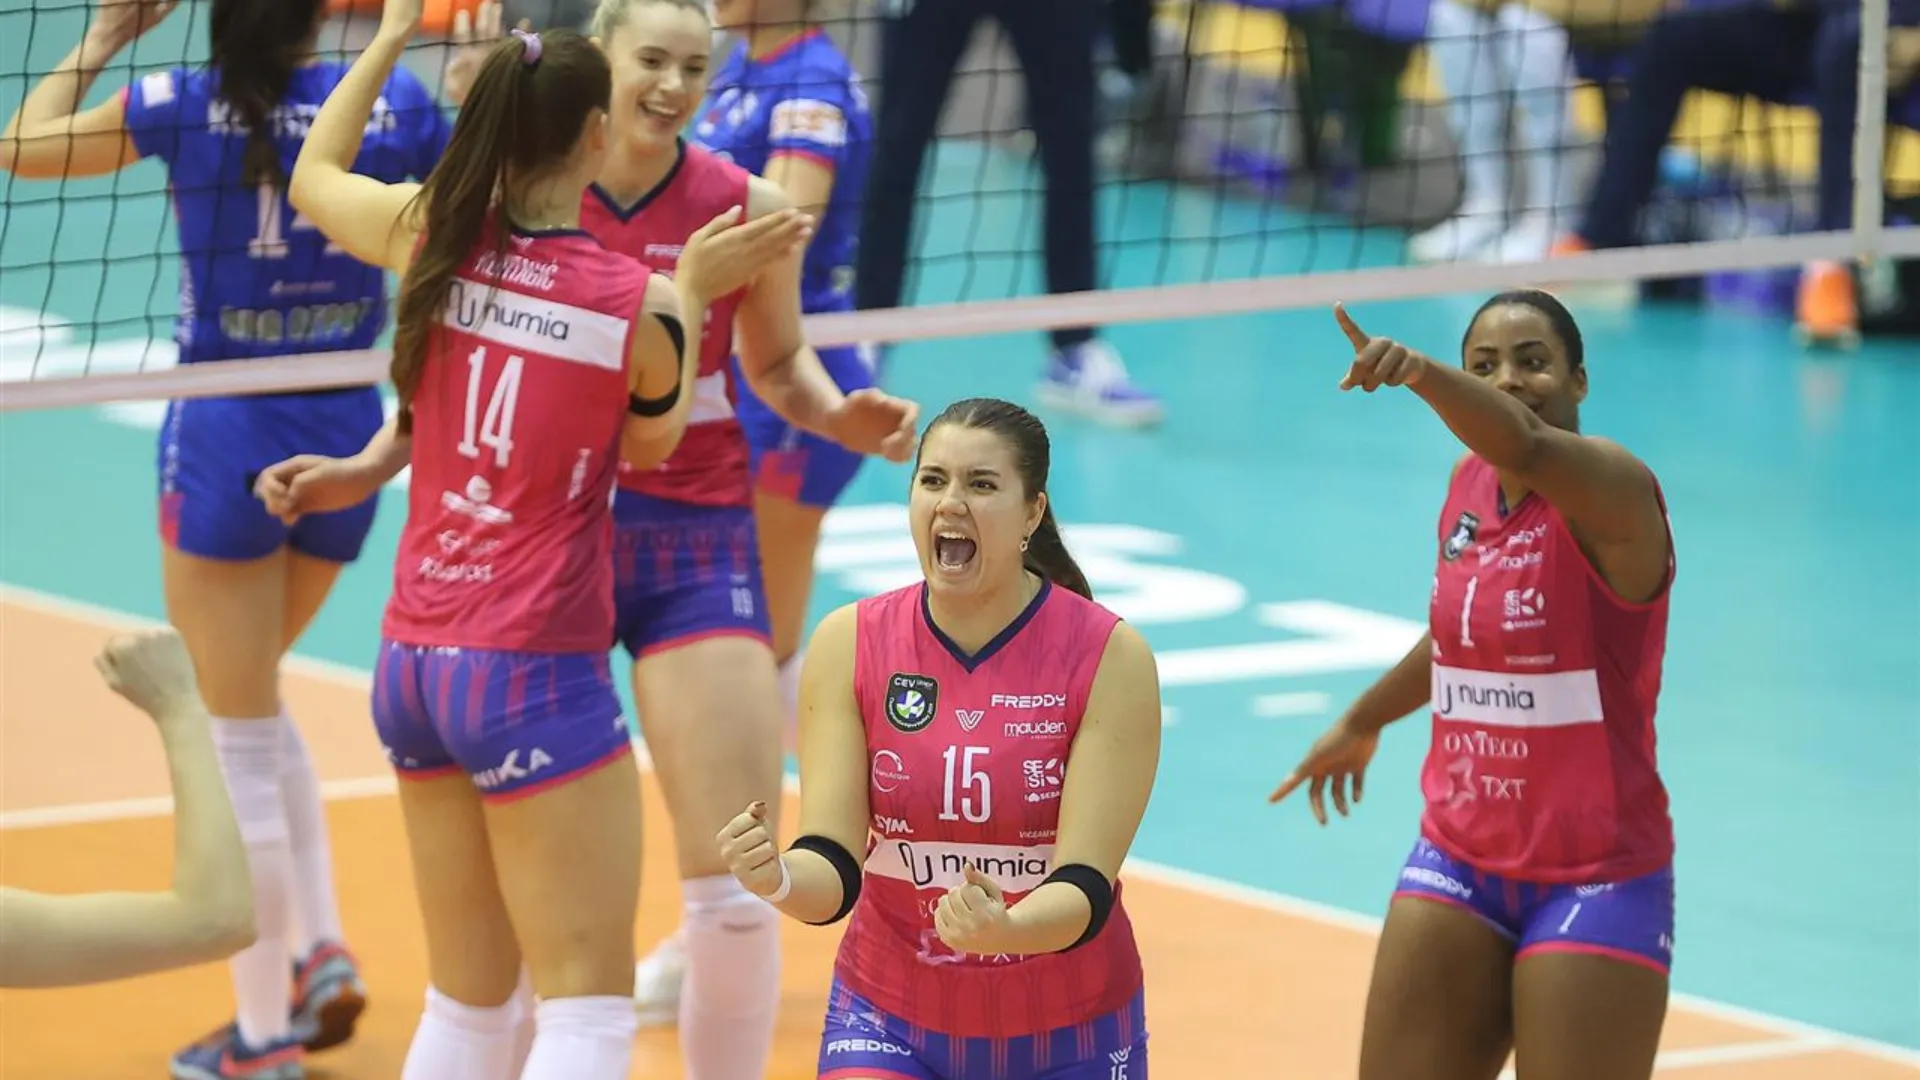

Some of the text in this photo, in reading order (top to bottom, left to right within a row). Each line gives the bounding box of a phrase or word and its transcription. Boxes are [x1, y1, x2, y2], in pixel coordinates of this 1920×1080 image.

[485, 303, 571, 341] numia
[457, 345, 525, 468] 14
[1460, 575, 1479, 647] 1
[894, 677, 915, 688] CEV
[991, 693, 1066, 709] FREDDY
[1459, 682, 1535, 710] numia
[1004, 719, 1067, 737] mauden
[1444, 730, 1529, 759] ONTECO
[938, 744, 992, 824] 15
[1480, 775, 1527, 800] TXT
[874, 813, 914, 835] SYM
[942, 853, 1047, 878] numia
